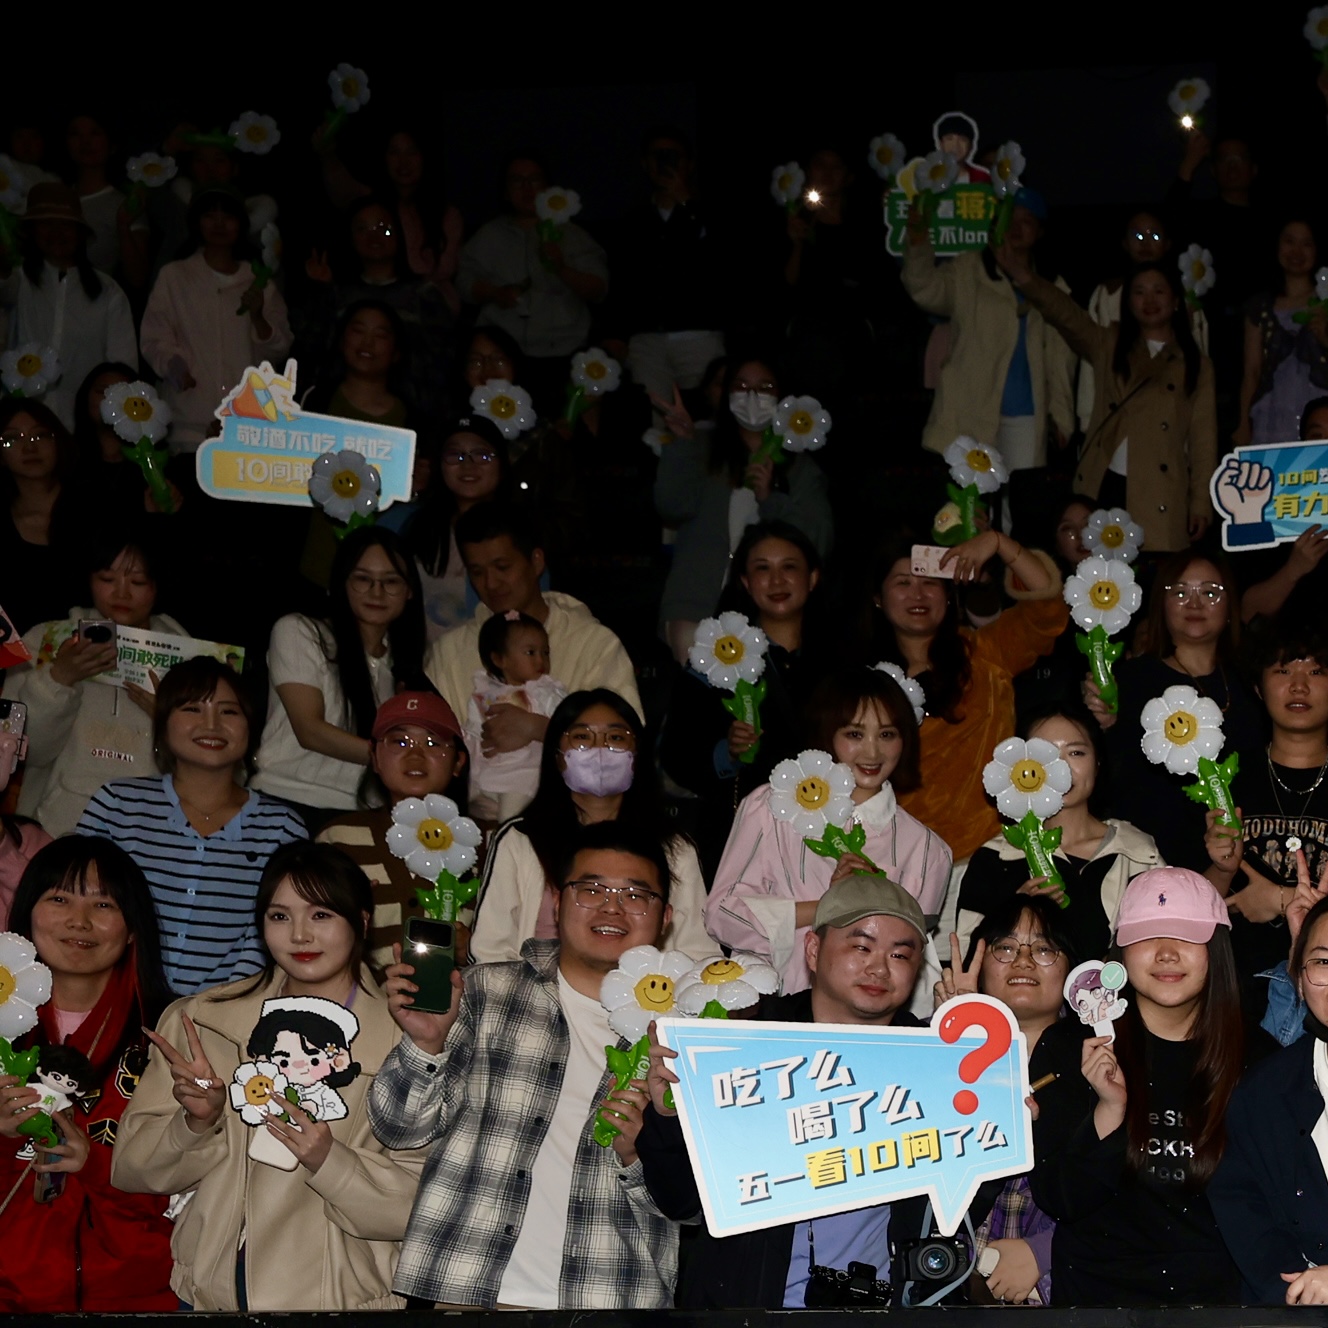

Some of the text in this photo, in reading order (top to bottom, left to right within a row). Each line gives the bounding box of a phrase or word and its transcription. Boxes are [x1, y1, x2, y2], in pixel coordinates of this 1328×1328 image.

[407, 699, 418, 711] C
[92, 749, 134, 763] ORIGINAL
[711, 1048, 857, 1110] 吃了么
[785, 1082, 926, 1146] 喝了么
[735, 1118, 1009, 1207] 五一看10间了么
